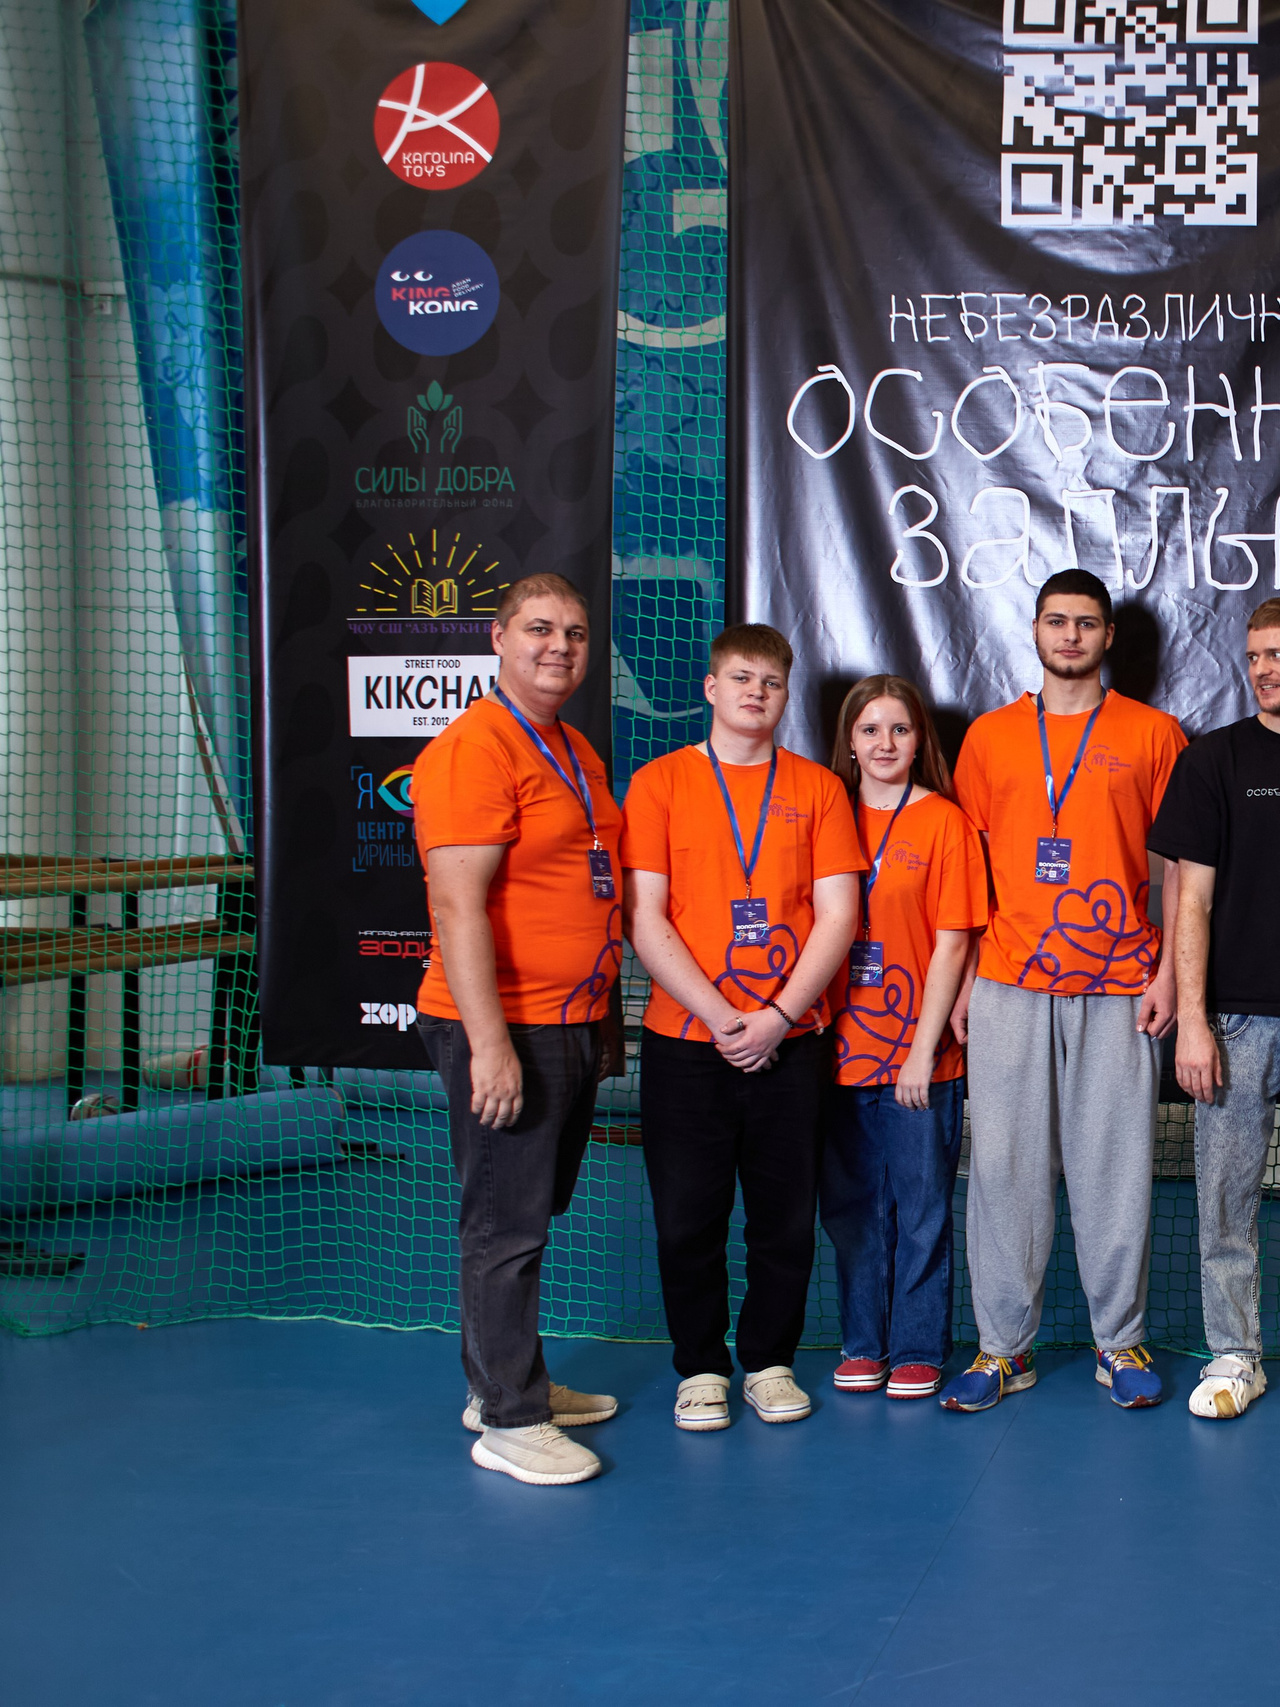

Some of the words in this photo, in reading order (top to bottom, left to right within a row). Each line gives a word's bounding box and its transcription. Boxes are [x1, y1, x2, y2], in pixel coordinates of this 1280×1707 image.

[403, 165, 446, 177] TOYS
[391, 286, 451, 301] KING
[408, 300, 479, 315] KONG
[355, 467, 426, 494] СИЛЫ
[435, 466, 515, 495] ДОБРА
[483, 498, 513, 508] ФОНД
[348, 622, 376, 634] ЧОУ
[379, 622, 402, 634] СШ
[441, 622, 479, 634] БУКИ
[405, 659, 435, 668] STREET
[438, 659, 461, 668] FOOD
[413, 717, 429, 726] EST.
[431, 716, 450, 726] 2012
[358, 821, 405, 842] ЦЕНТР
[358, 844, 415, 867] ИРИНЫ
